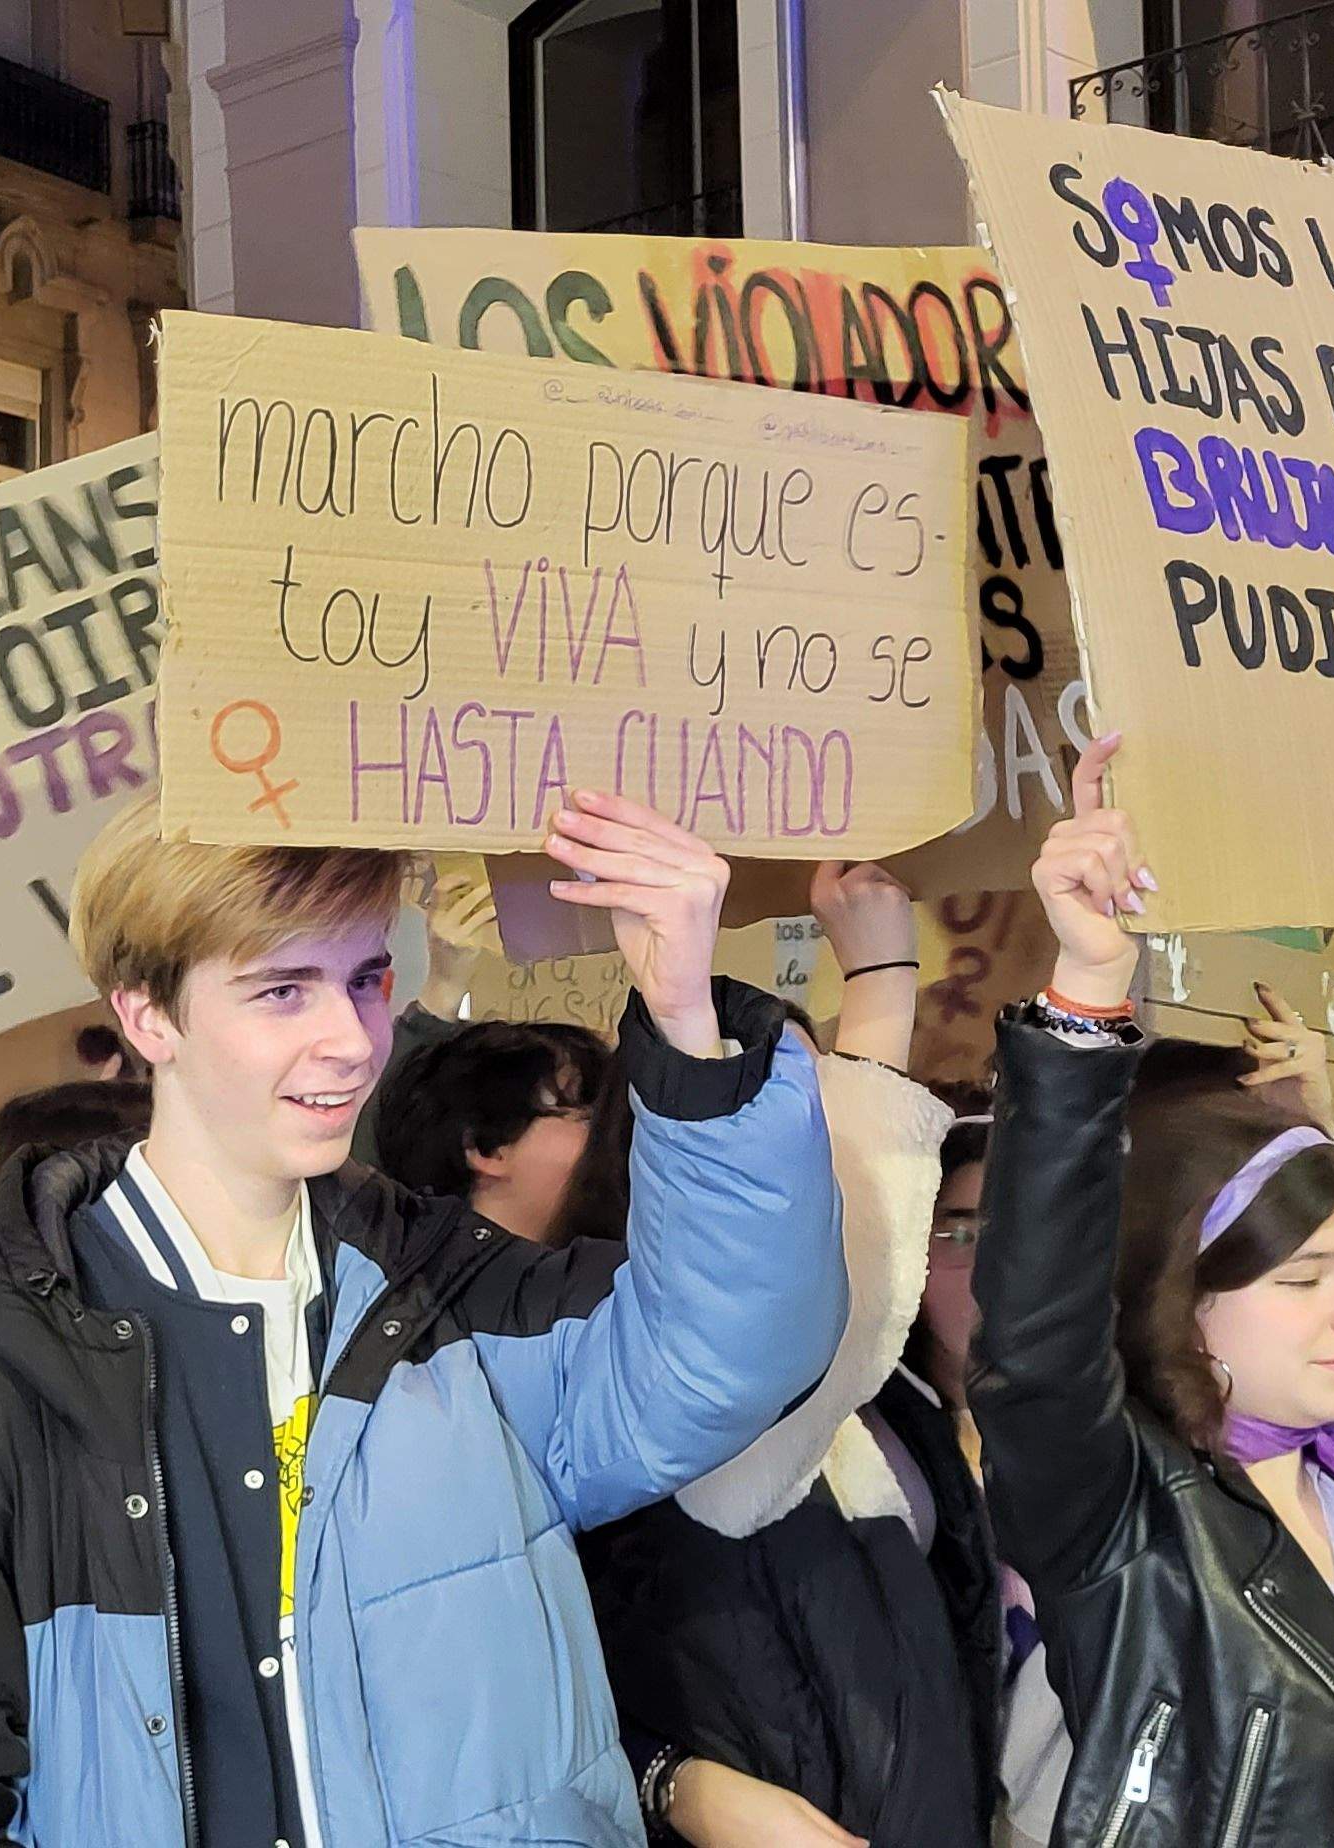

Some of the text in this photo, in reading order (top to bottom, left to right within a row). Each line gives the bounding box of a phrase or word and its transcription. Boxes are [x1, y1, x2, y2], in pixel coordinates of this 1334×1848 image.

[1049, 164, 1293, 308] SOMOS
[1081, 303, 1307, 437] HIJAS
[219, 374, 533, 528] marcho
[585, 441, 814, 600] porque
[270, 545, 432, 702] toy
[689, 620, 727, 717] y
[757, 624, 838, 693] no
[870, 634, 932, 708] se
[347, 702, 853, 838] HASTA CUANDO
